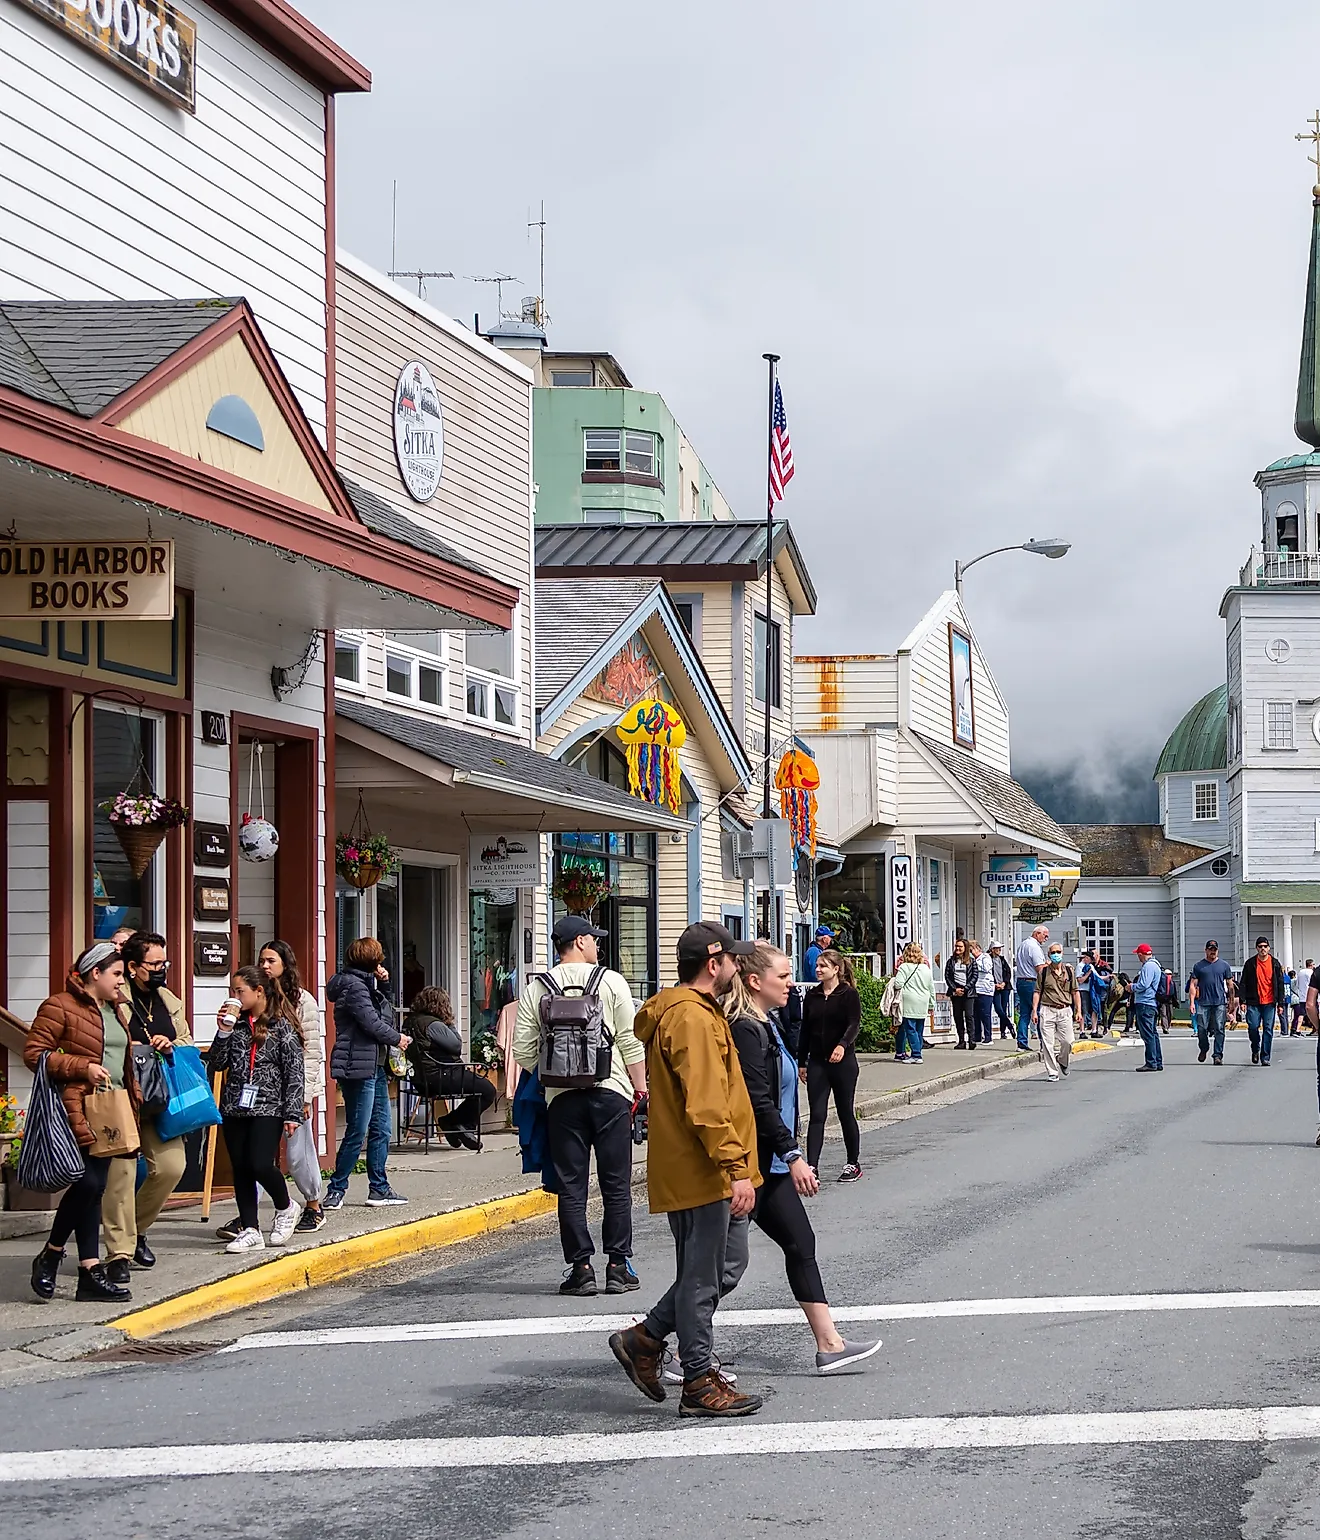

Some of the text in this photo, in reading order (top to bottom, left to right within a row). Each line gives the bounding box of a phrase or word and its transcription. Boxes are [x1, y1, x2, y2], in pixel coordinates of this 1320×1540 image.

[62, 0, 183, 78] OOKS
[404, 423, 436, 456] SITKA
[407, 460, 435, 481] LIGHTHOUSE
[0, 546, 166, 575] OLD HARBOR
[30, 580, 129, 609] BOOKS
[209, 715, 226, 740] 201
[494, 863, 537, 871] LIGHTHOUSE
[986, 872, 1044, 883] Blue Eyed
[996, 883, 1034, 893] BEAR
